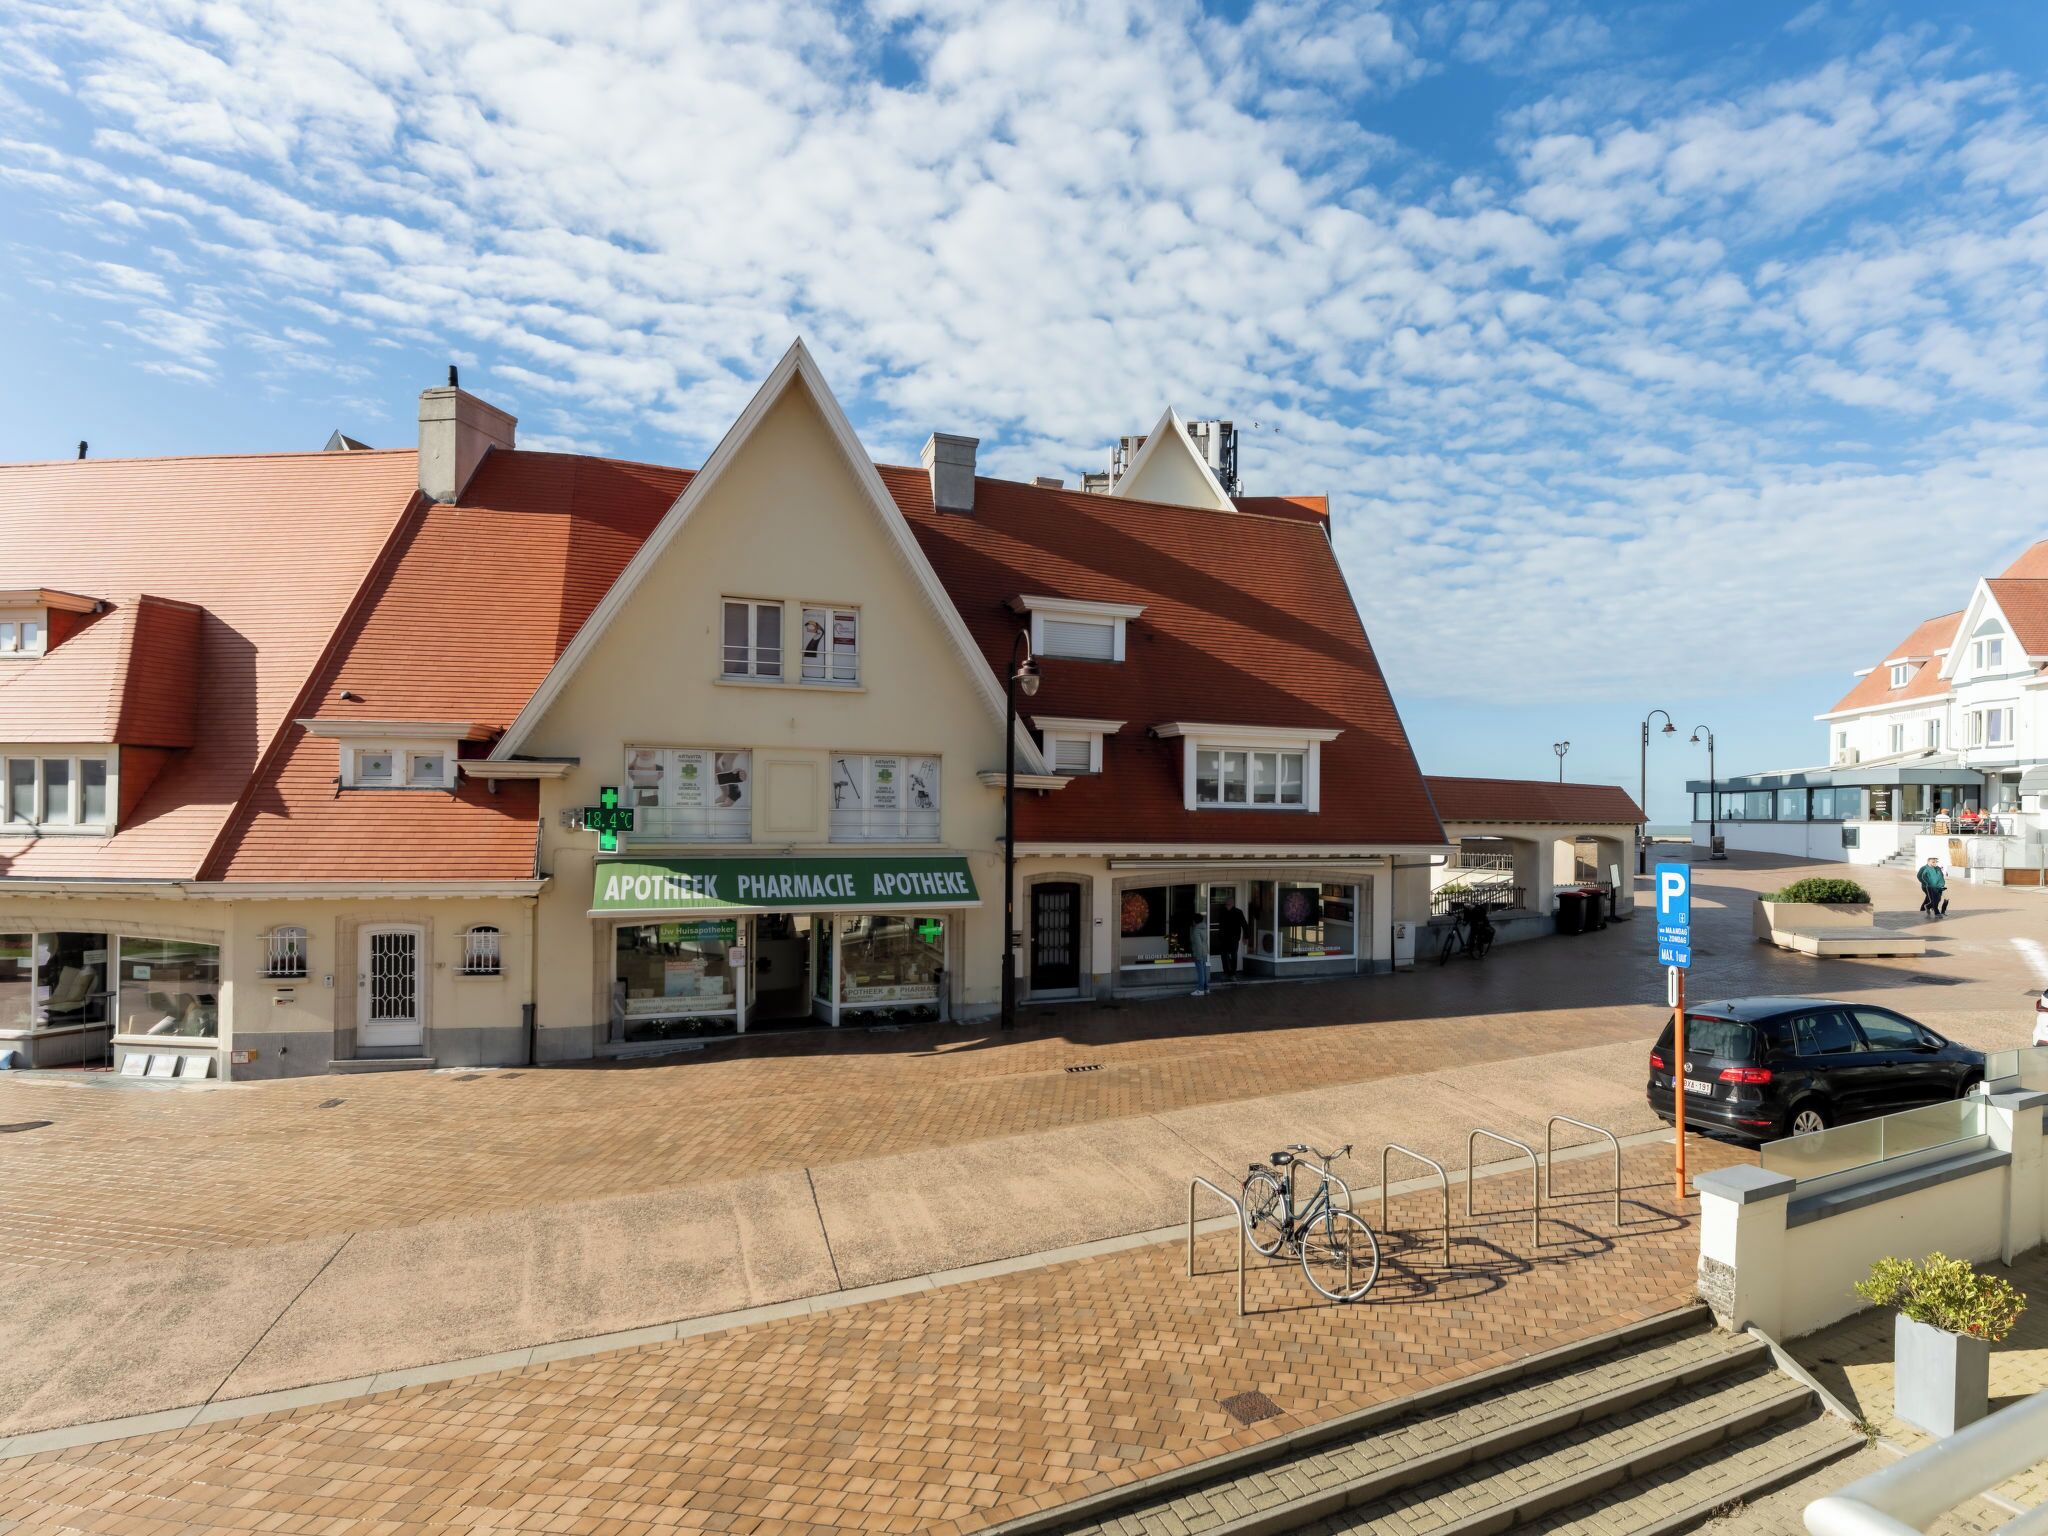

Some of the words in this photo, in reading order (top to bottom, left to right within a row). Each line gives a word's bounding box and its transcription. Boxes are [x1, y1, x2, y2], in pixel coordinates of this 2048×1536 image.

[604, 875, 717, 901] APOTHEEK
[738, 873, 856, 899] PHARMACIE
[873, 871, 970, 896] APOTHEKE
[1661, 871, 1686, 914] P
[660, 927, 674, 936] Uw
[676, 925, 736, 936] Huisapotheker
[1665, 927, 1688, 936] MAANDAG
[1668, 935, 1687, 944] ZONDAG
[1661, 948, 1675, 962] MAX.
[900, 984, 938, 993] PHARMAC
